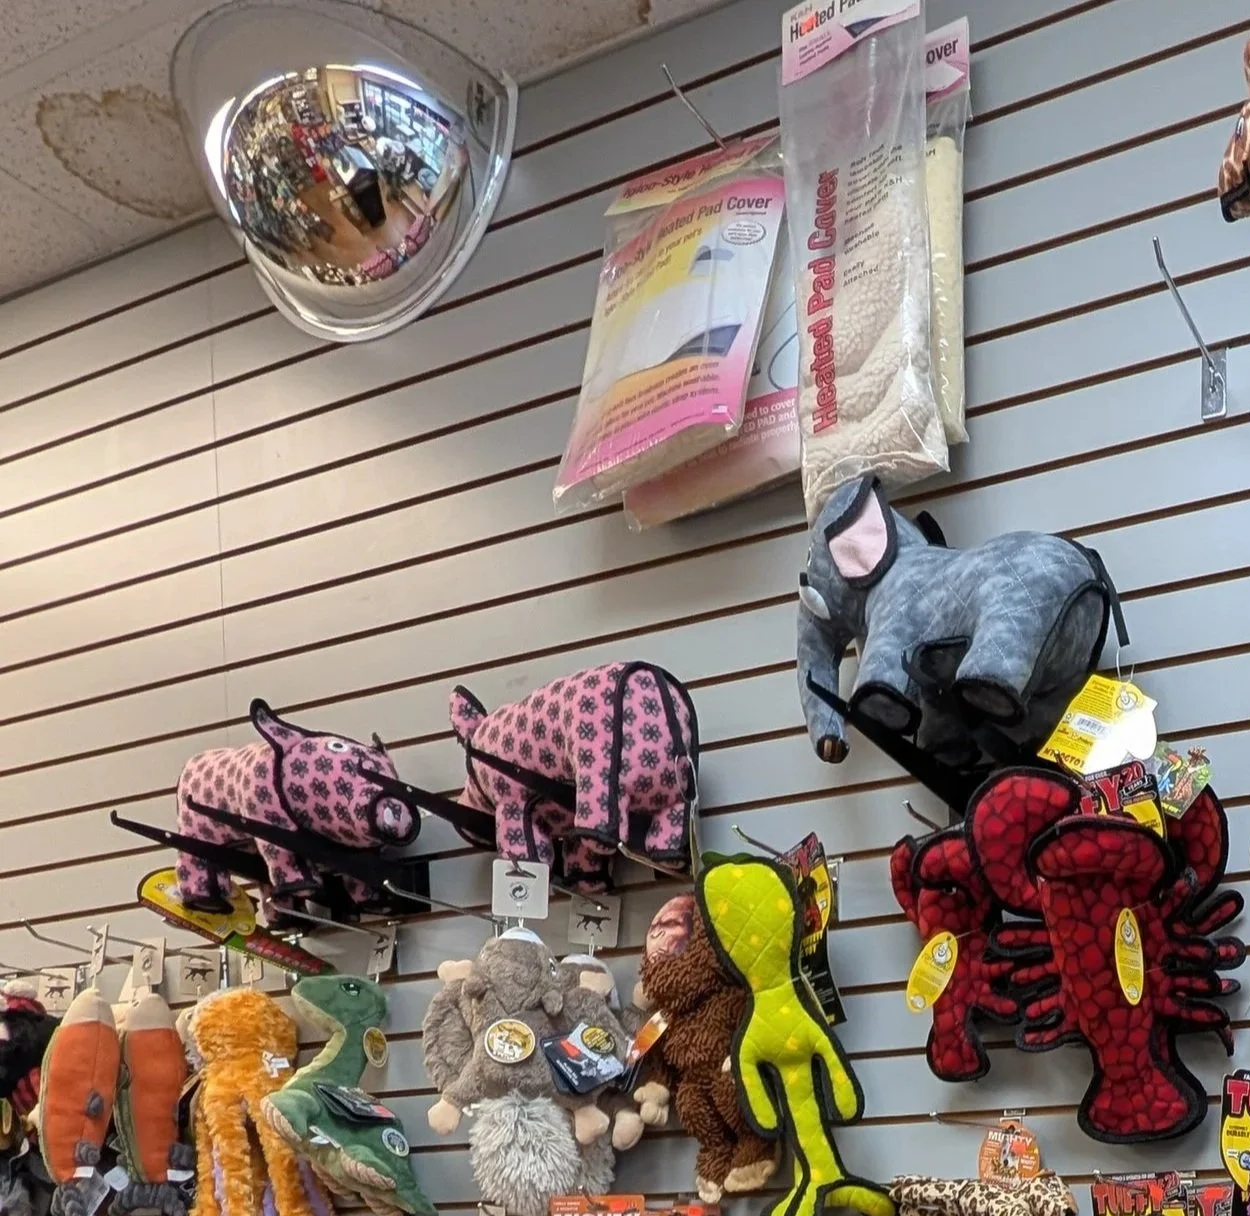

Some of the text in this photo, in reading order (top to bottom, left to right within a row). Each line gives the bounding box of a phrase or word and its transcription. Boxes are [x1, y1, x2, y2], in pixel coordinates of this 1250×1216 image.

[790, 3, 835, 43] Hted
[926, 38, 959, 64] over
[697, 196, 773, 221] Pad Cover
[807, 168, 840, 434] Heated Pad Cover
[770, 399, 796, 413] cover
[757, 409, 797, 429] PAD and
[1122, 764, 1144, 785] 20
[1093, 1179, 1164, 1215] TUFFY
